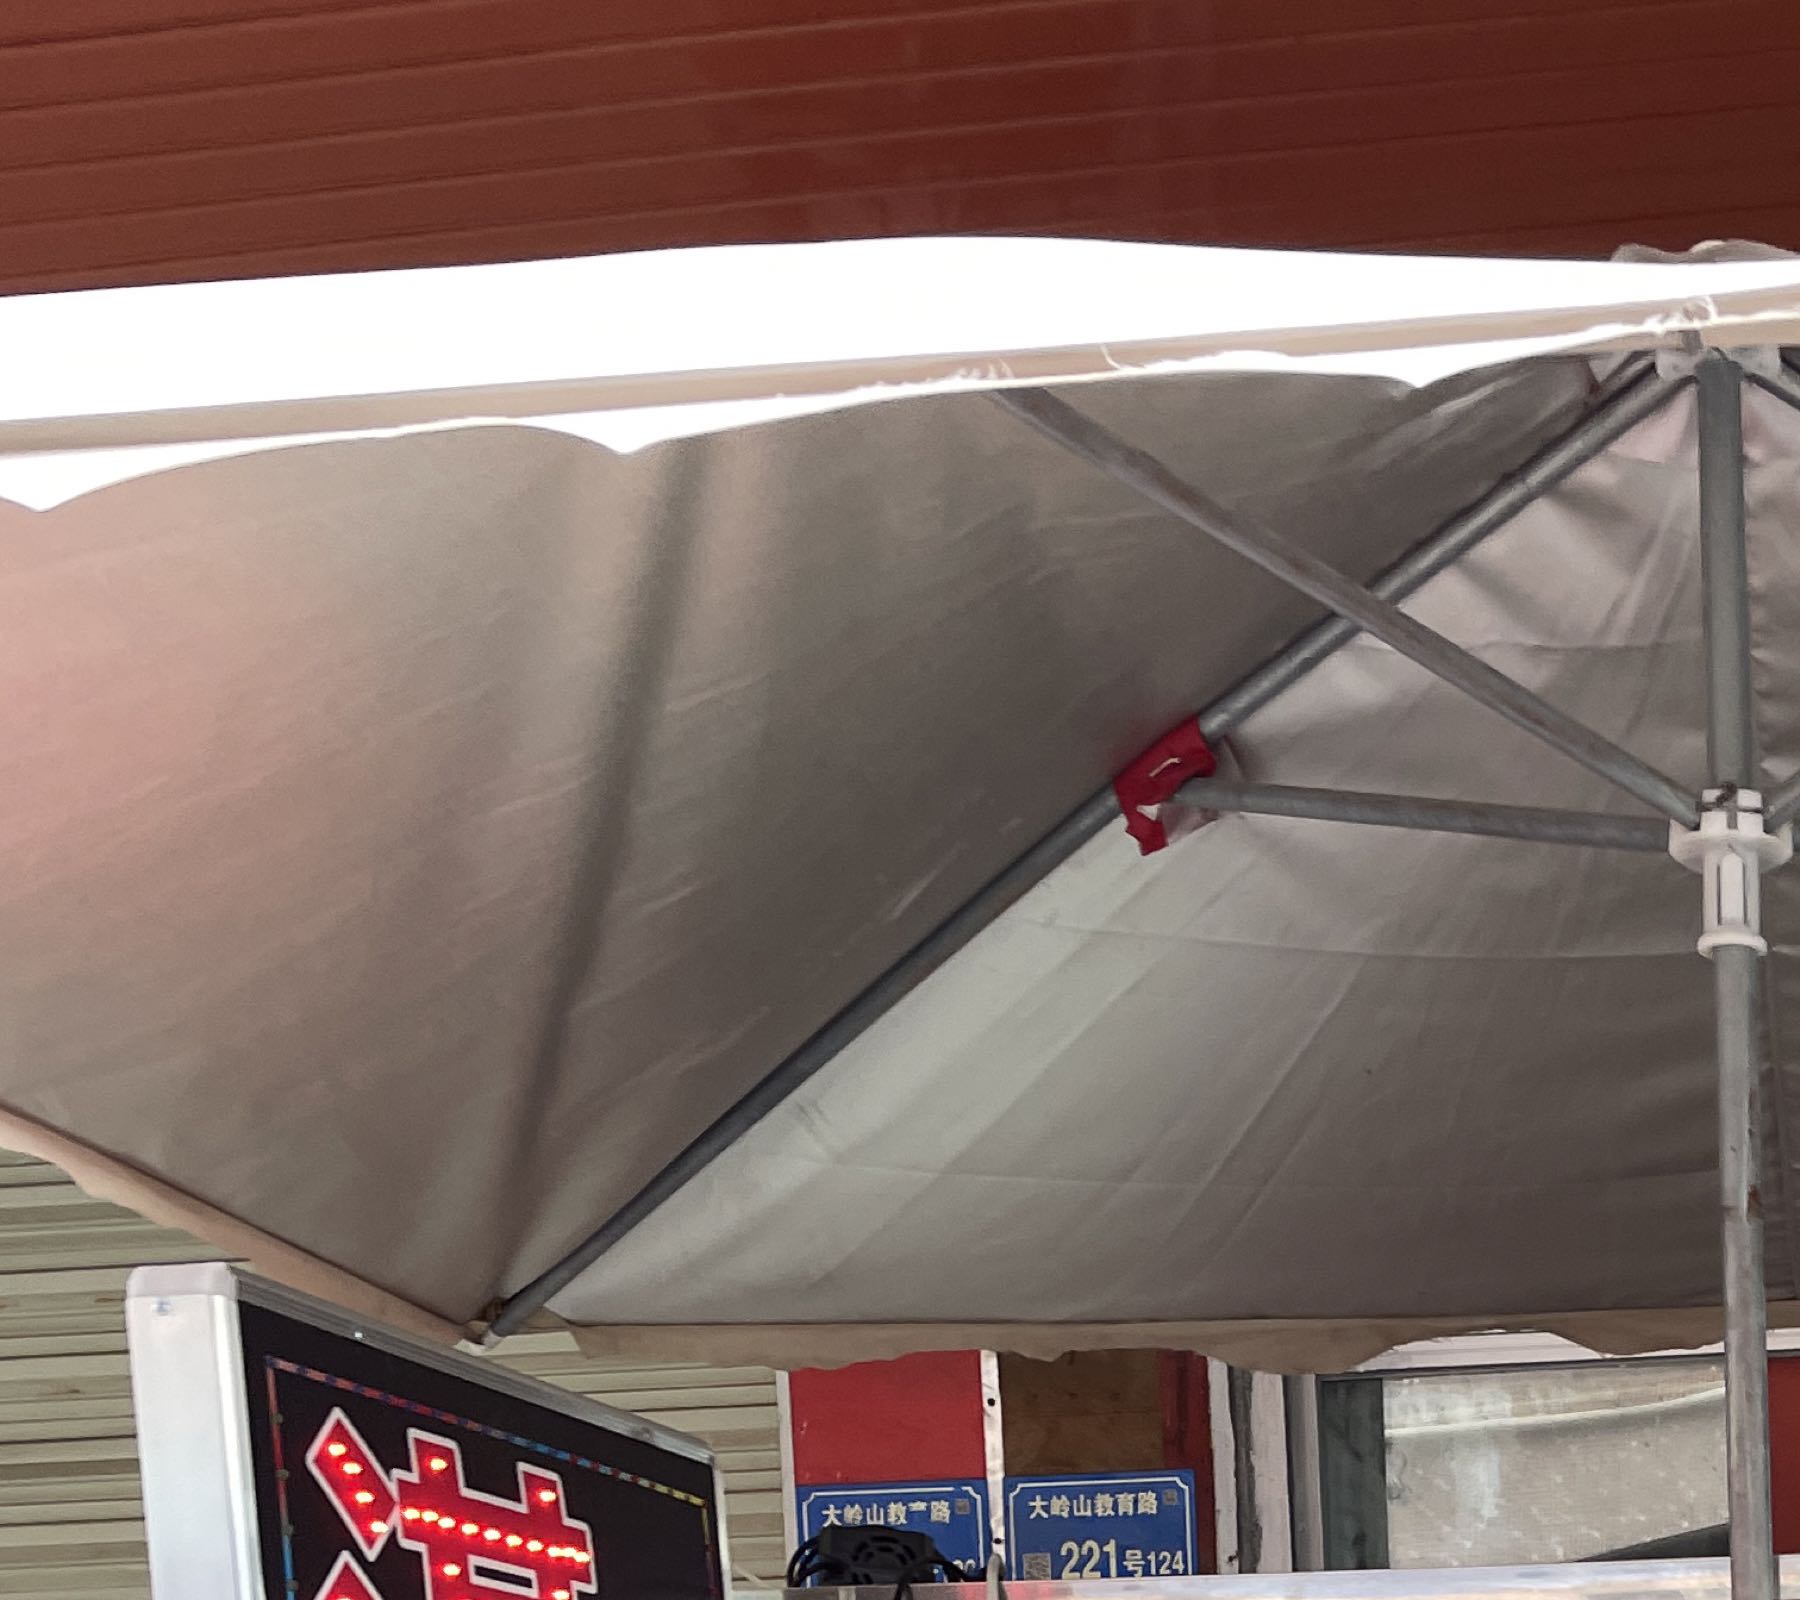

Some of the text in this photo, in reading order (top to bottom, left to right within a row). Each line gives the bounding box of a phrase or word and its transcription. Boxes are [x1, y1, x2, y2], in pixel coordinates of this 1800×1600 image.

[1028, 1489, 1158, 1519] 大岭山教育路
